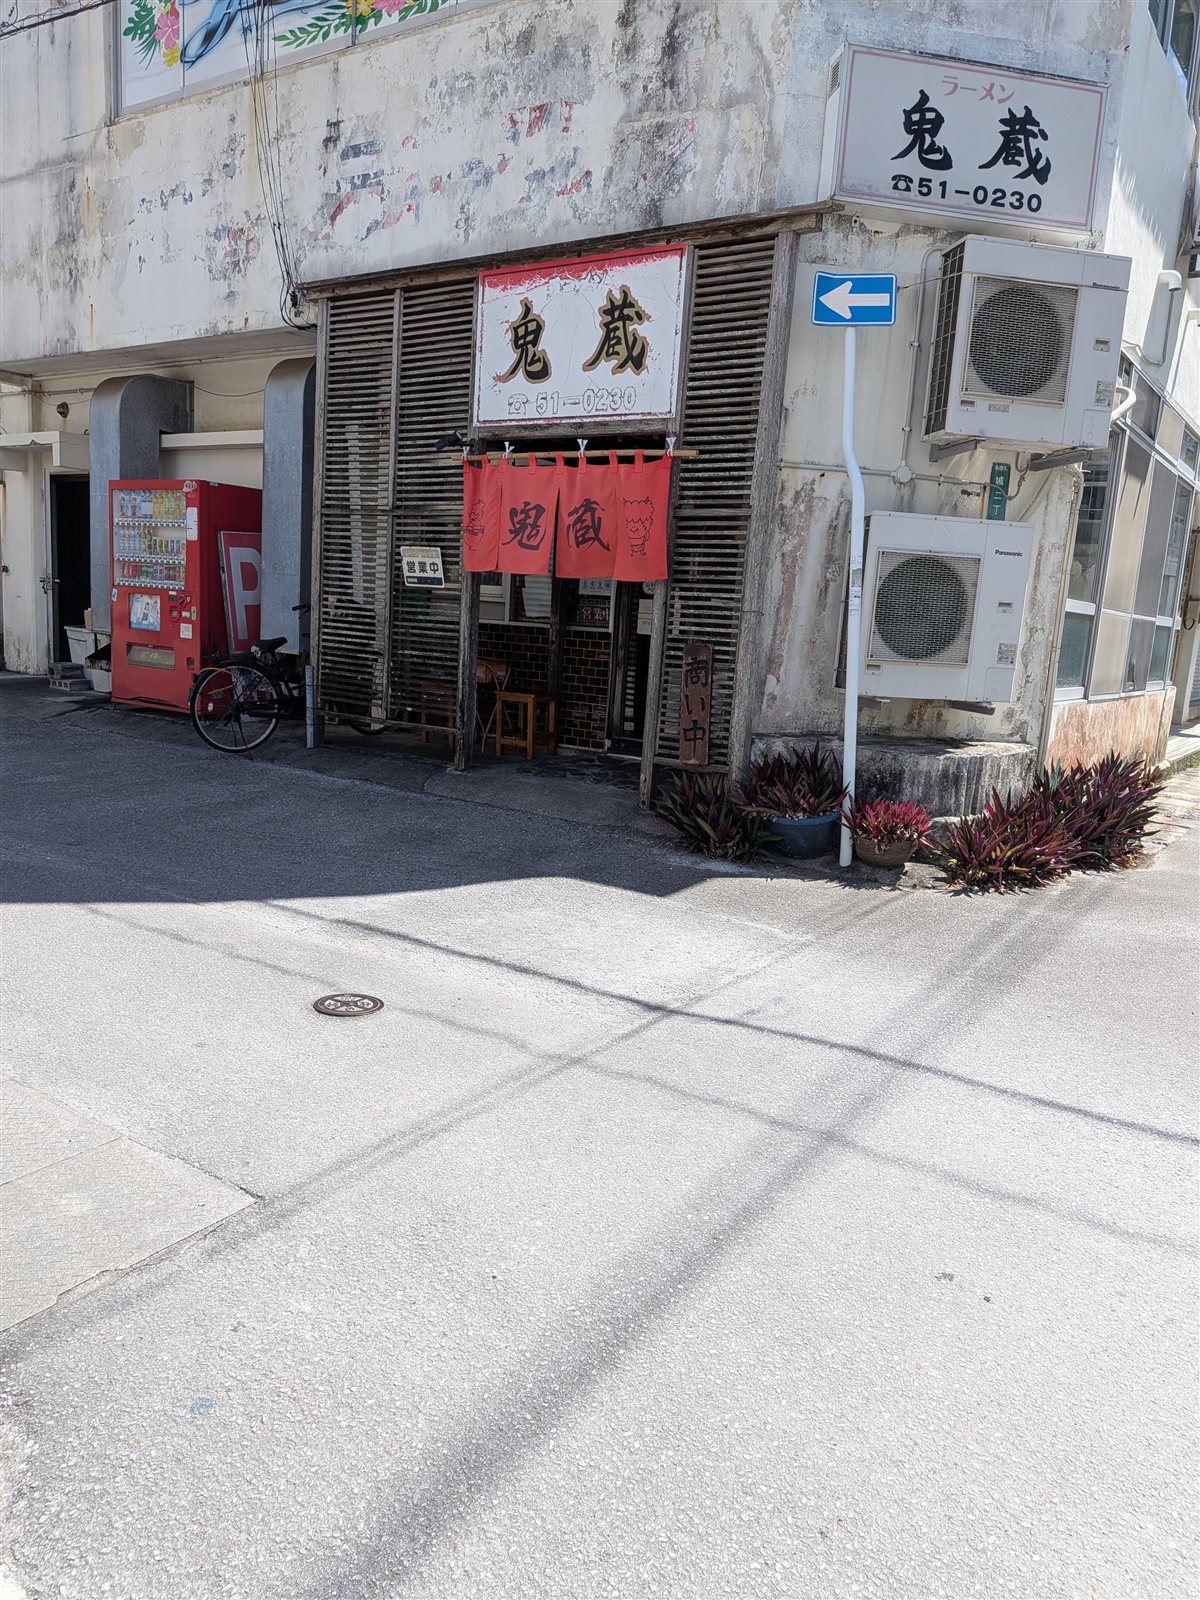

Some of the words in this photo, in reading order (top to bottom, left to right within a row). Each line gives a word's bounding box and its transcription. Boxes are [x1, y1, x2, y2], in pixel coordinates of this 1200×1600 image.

[941, 75, 1016, 104] ラーメン
[890, 89, 1051, 186] 鬼蔵
[503, 285, 648, 383] 鬼蔵
[228, 546, 262, 640] P
[406, 560, 439, 575] 営業中
[995, 549, 1024, 557] Panasonic
[682, 656, 710, 760] 商い中
